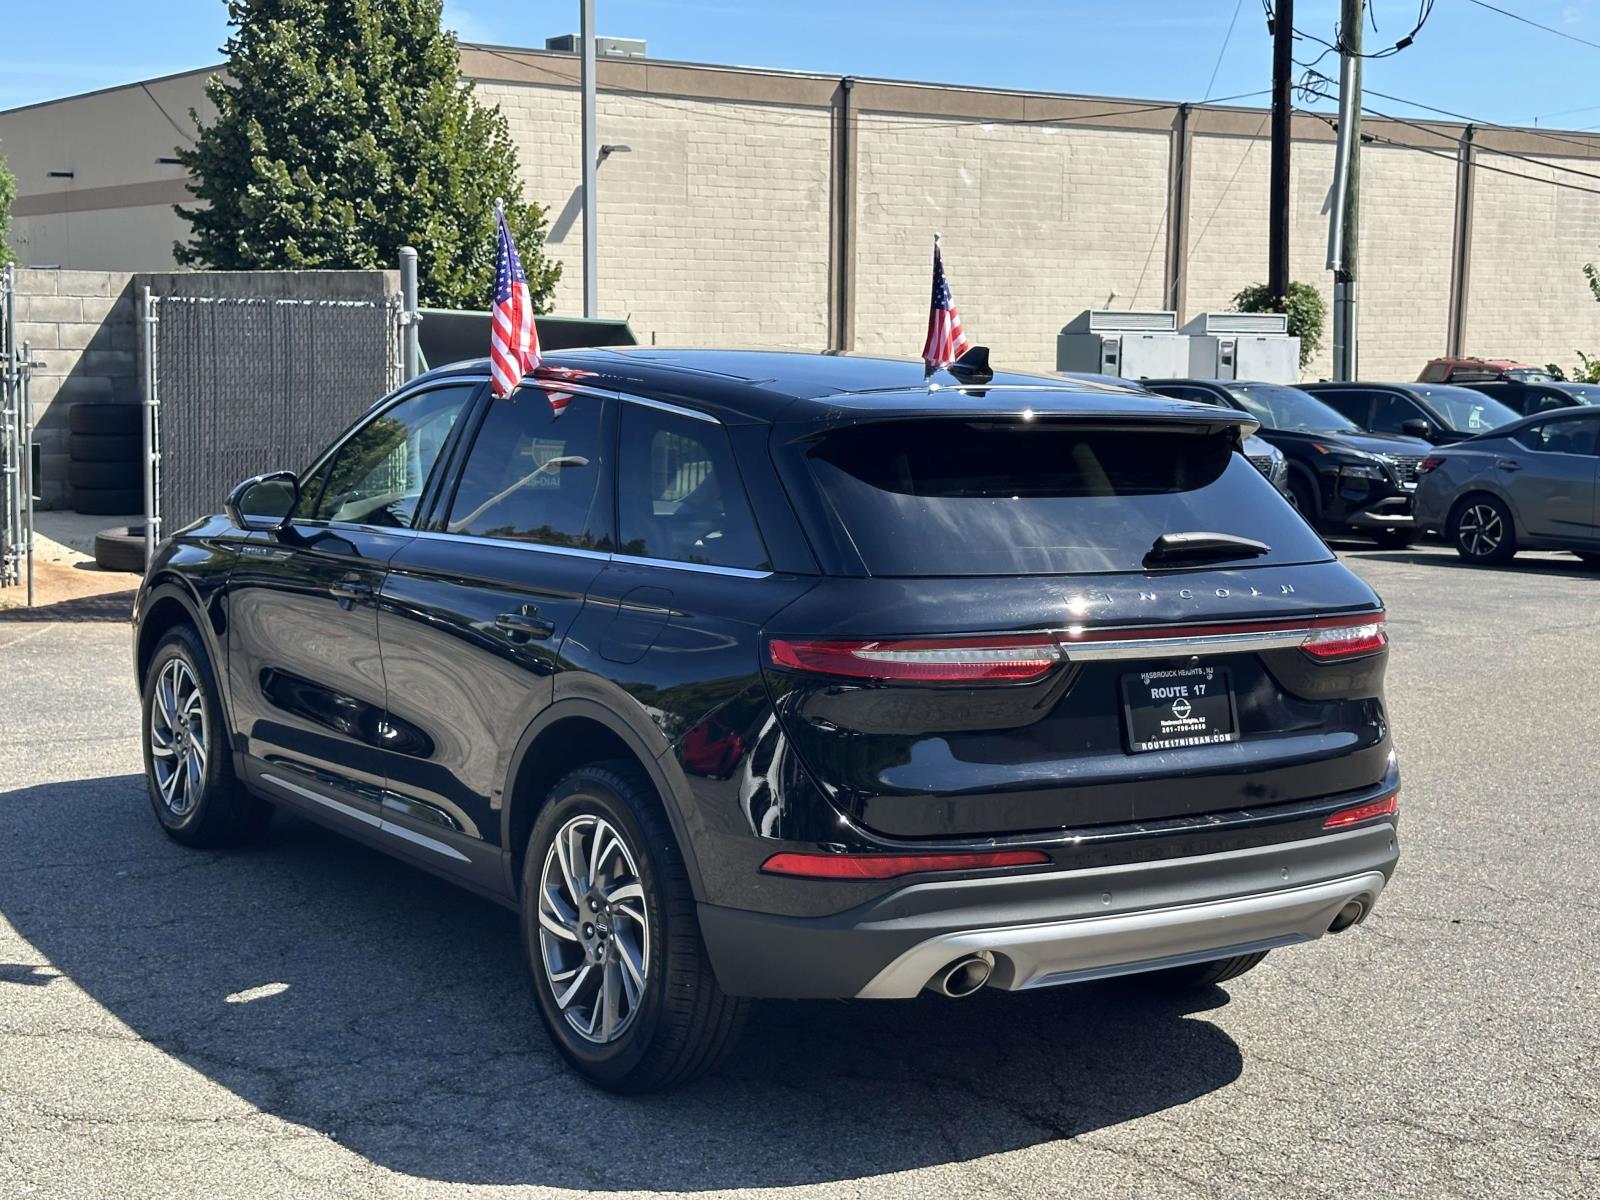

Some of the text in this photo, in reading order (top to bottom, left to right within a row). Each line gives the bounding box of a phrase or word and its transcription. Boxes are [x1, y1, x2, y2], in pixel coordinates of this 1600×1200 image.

[1141, 670, 1177, 679] HASBROUCK
[1151, 684, 1206, 699] ROUTE 17
[1141, 734, 1231, 751] ROUTE17NISSAN.COM
